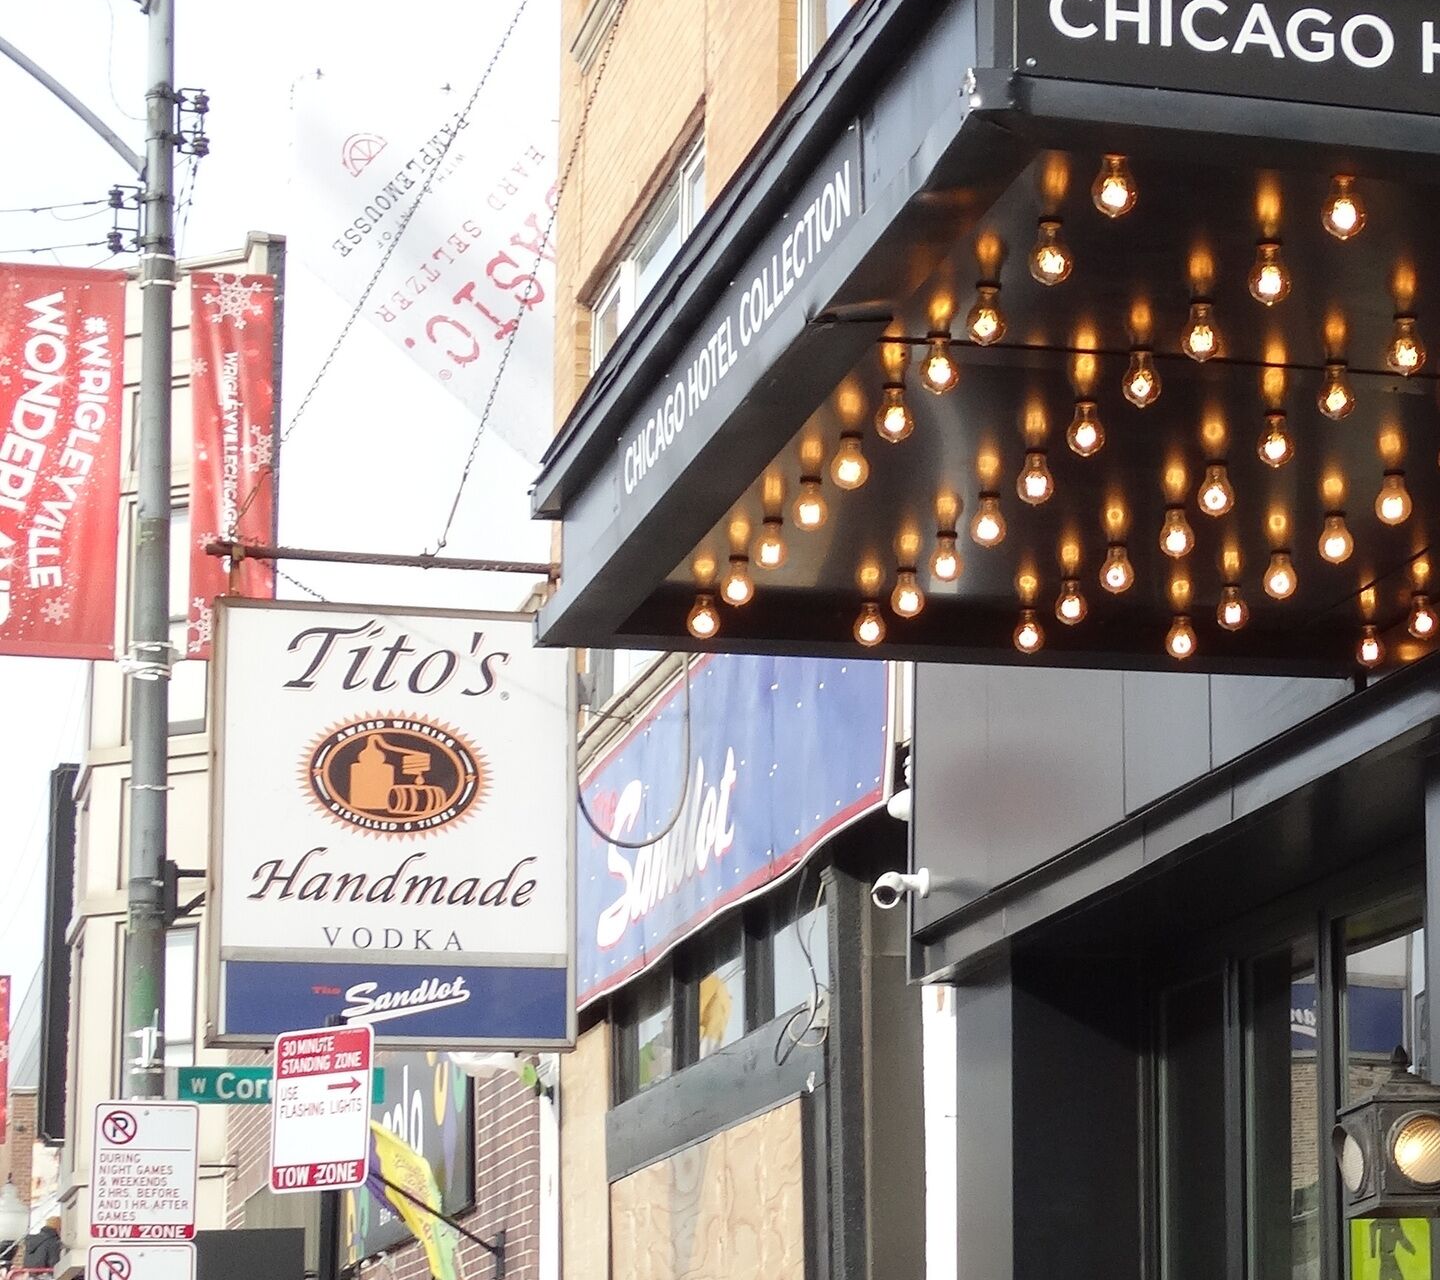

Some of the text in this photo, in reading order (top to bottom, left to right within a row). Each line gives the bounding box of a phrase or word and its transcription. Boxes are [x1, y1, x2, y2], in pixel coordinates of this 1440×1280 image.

[332, 112, 469, 257] PAMPLEMOUSSE
[375, 145, 545, 323] HARD SELTZER
[624, 160, 851, 495] CHICAGO HOTEL COLLECTION
[29, 316, 112, 589] #WRIGLEYVILLE
[282, 619, 512, 697] Tito's
[335, 720, 455, 748] AWARD WINNING
[330, 803, 398, 831] DISTILLED
[416, 807, 457, 829] TIMES
[597, 746, 737, 948] Sandlot
[246, 846, 539, 908] Handmade
[321, 926, 464, 952] VODKA
[341, 976, 471, 1022] Sandlot
[281, 1036, 335, 1057] 30 MINUTE
[281, 1051, 362, 1075] STANDING ZONE
[191, 1077, 206, 1094] W
[280, 1085, 299, 1101] USE
[279, 1098, 363, 1119] FLASHING LIGHTS
[99, 1153, 141, 1163] DURING
[99, 1165, 173, 1175] NIGHT GAMES
[99, 1177, 168, 1186] & WEEKENDS
[276, 1162, 358, 1188] TOW ZONE
[97, 1200, 121, 1209] AND
[153, 1200, 189, 1210] AFTER
[98, 1188, 105, 1198] 2
[137, 1188, 180, 1198] BEFORE
[97, 1211, 136, 1221] GAMES
[95, 1225, 187, 1239] TOW ZONE
